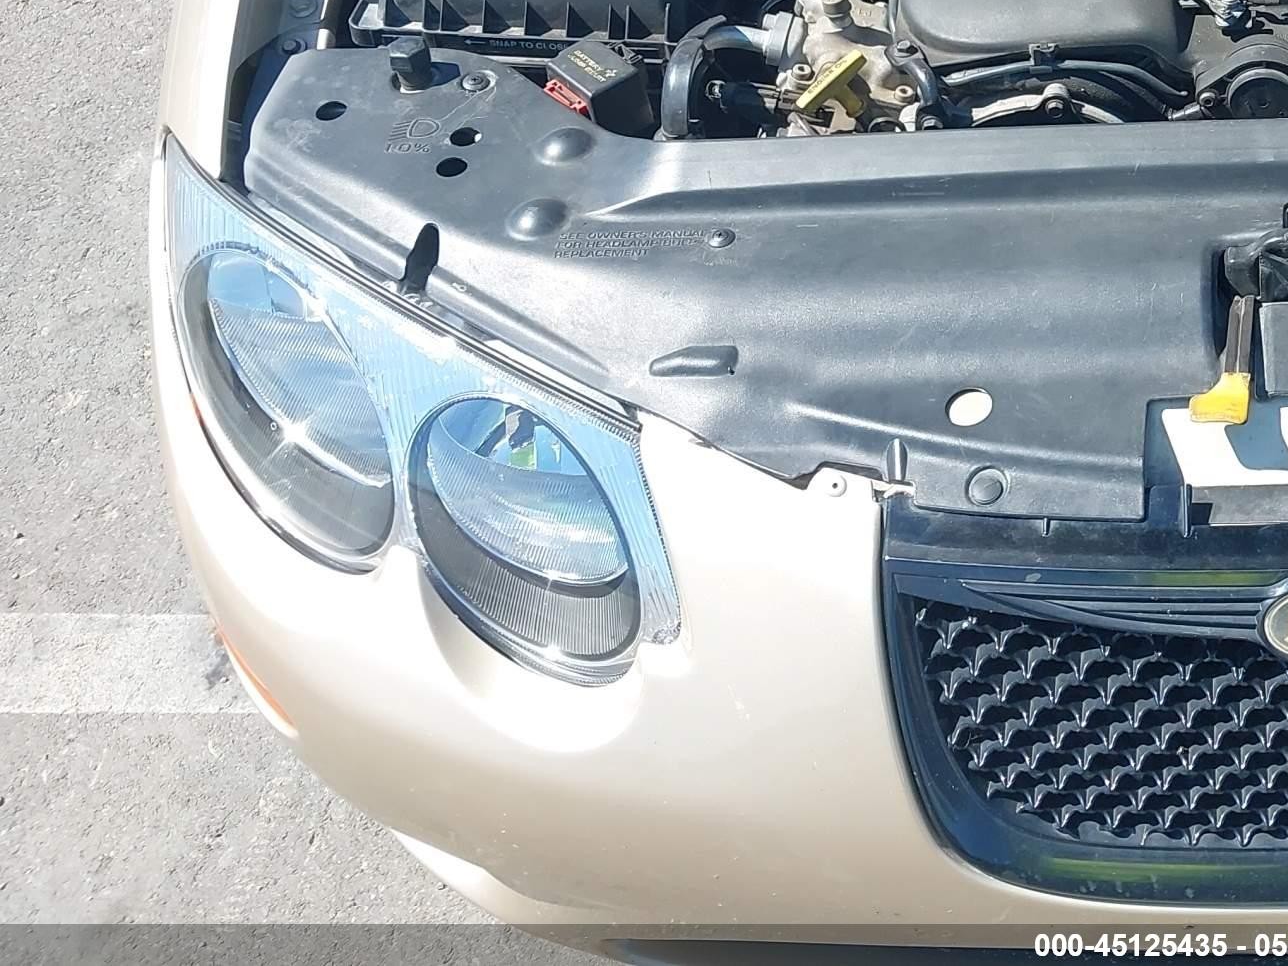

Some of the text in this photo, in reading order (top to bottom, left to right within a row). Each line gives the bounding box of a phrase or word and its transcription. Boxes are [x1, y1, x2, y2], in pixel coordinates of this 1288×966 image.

[488, 39, 517, 48] SNAP
[519, 41, 534, 49] TO
[559, 229, 705, 240] SEE OWNER'S MANUAL
[555, 240, 582, 249] FOR
[585, 239, 660, 249] HEADLAMP
[554, 248, 650, 258] REPLACEMENT
